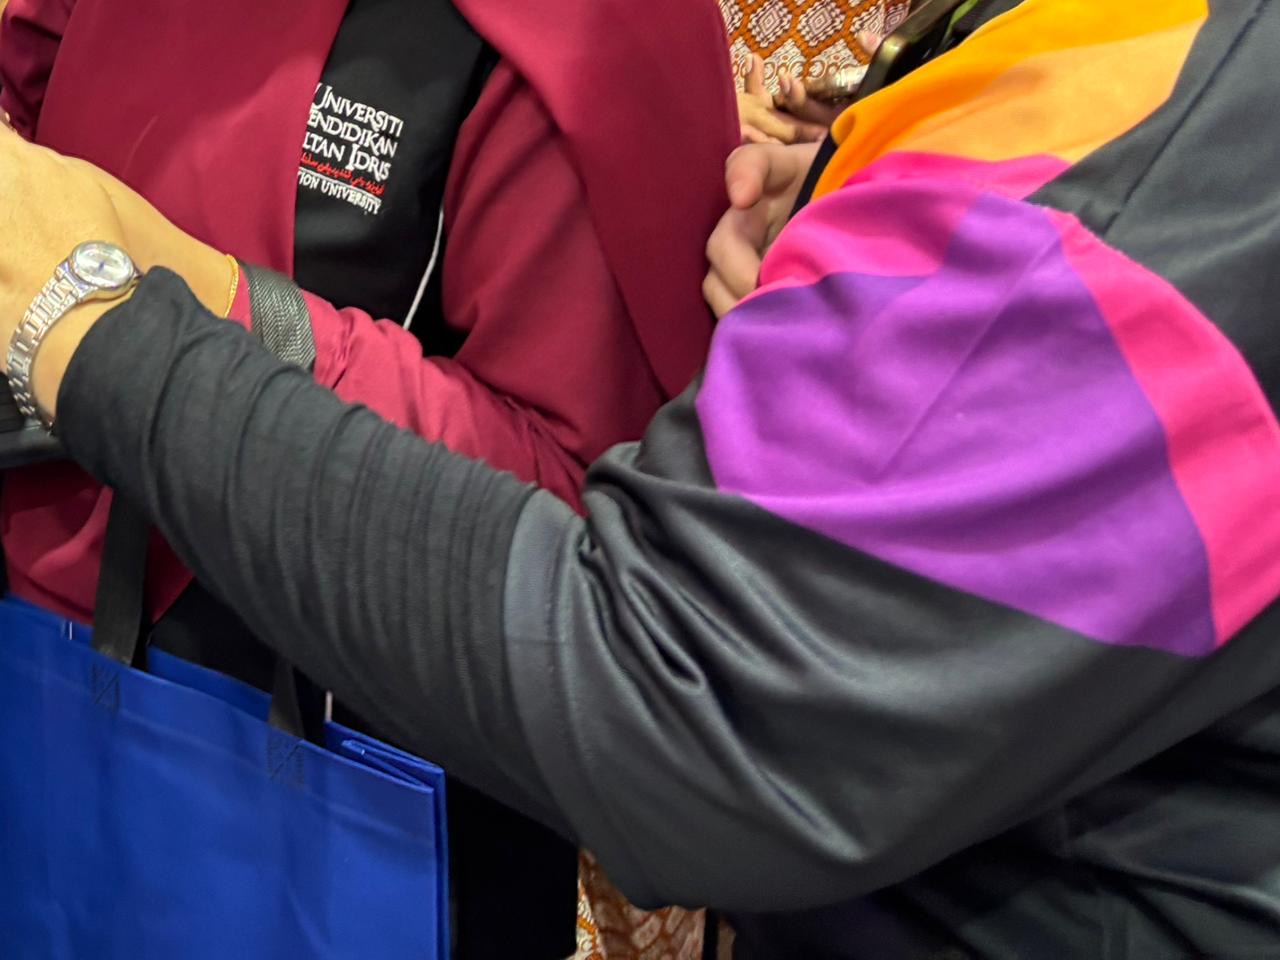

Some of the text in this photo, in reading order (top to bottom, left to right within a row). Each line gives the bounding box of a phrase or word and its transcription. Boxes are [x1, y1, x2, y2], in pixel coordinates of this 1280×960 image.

[302, 131, 346, 162] LTAN
[345, 143, 391, 182] IDRIS
[307, 109, 398, 158] ENDIDIKAN
[321, 179, 382, 215] UNIVERSITY
